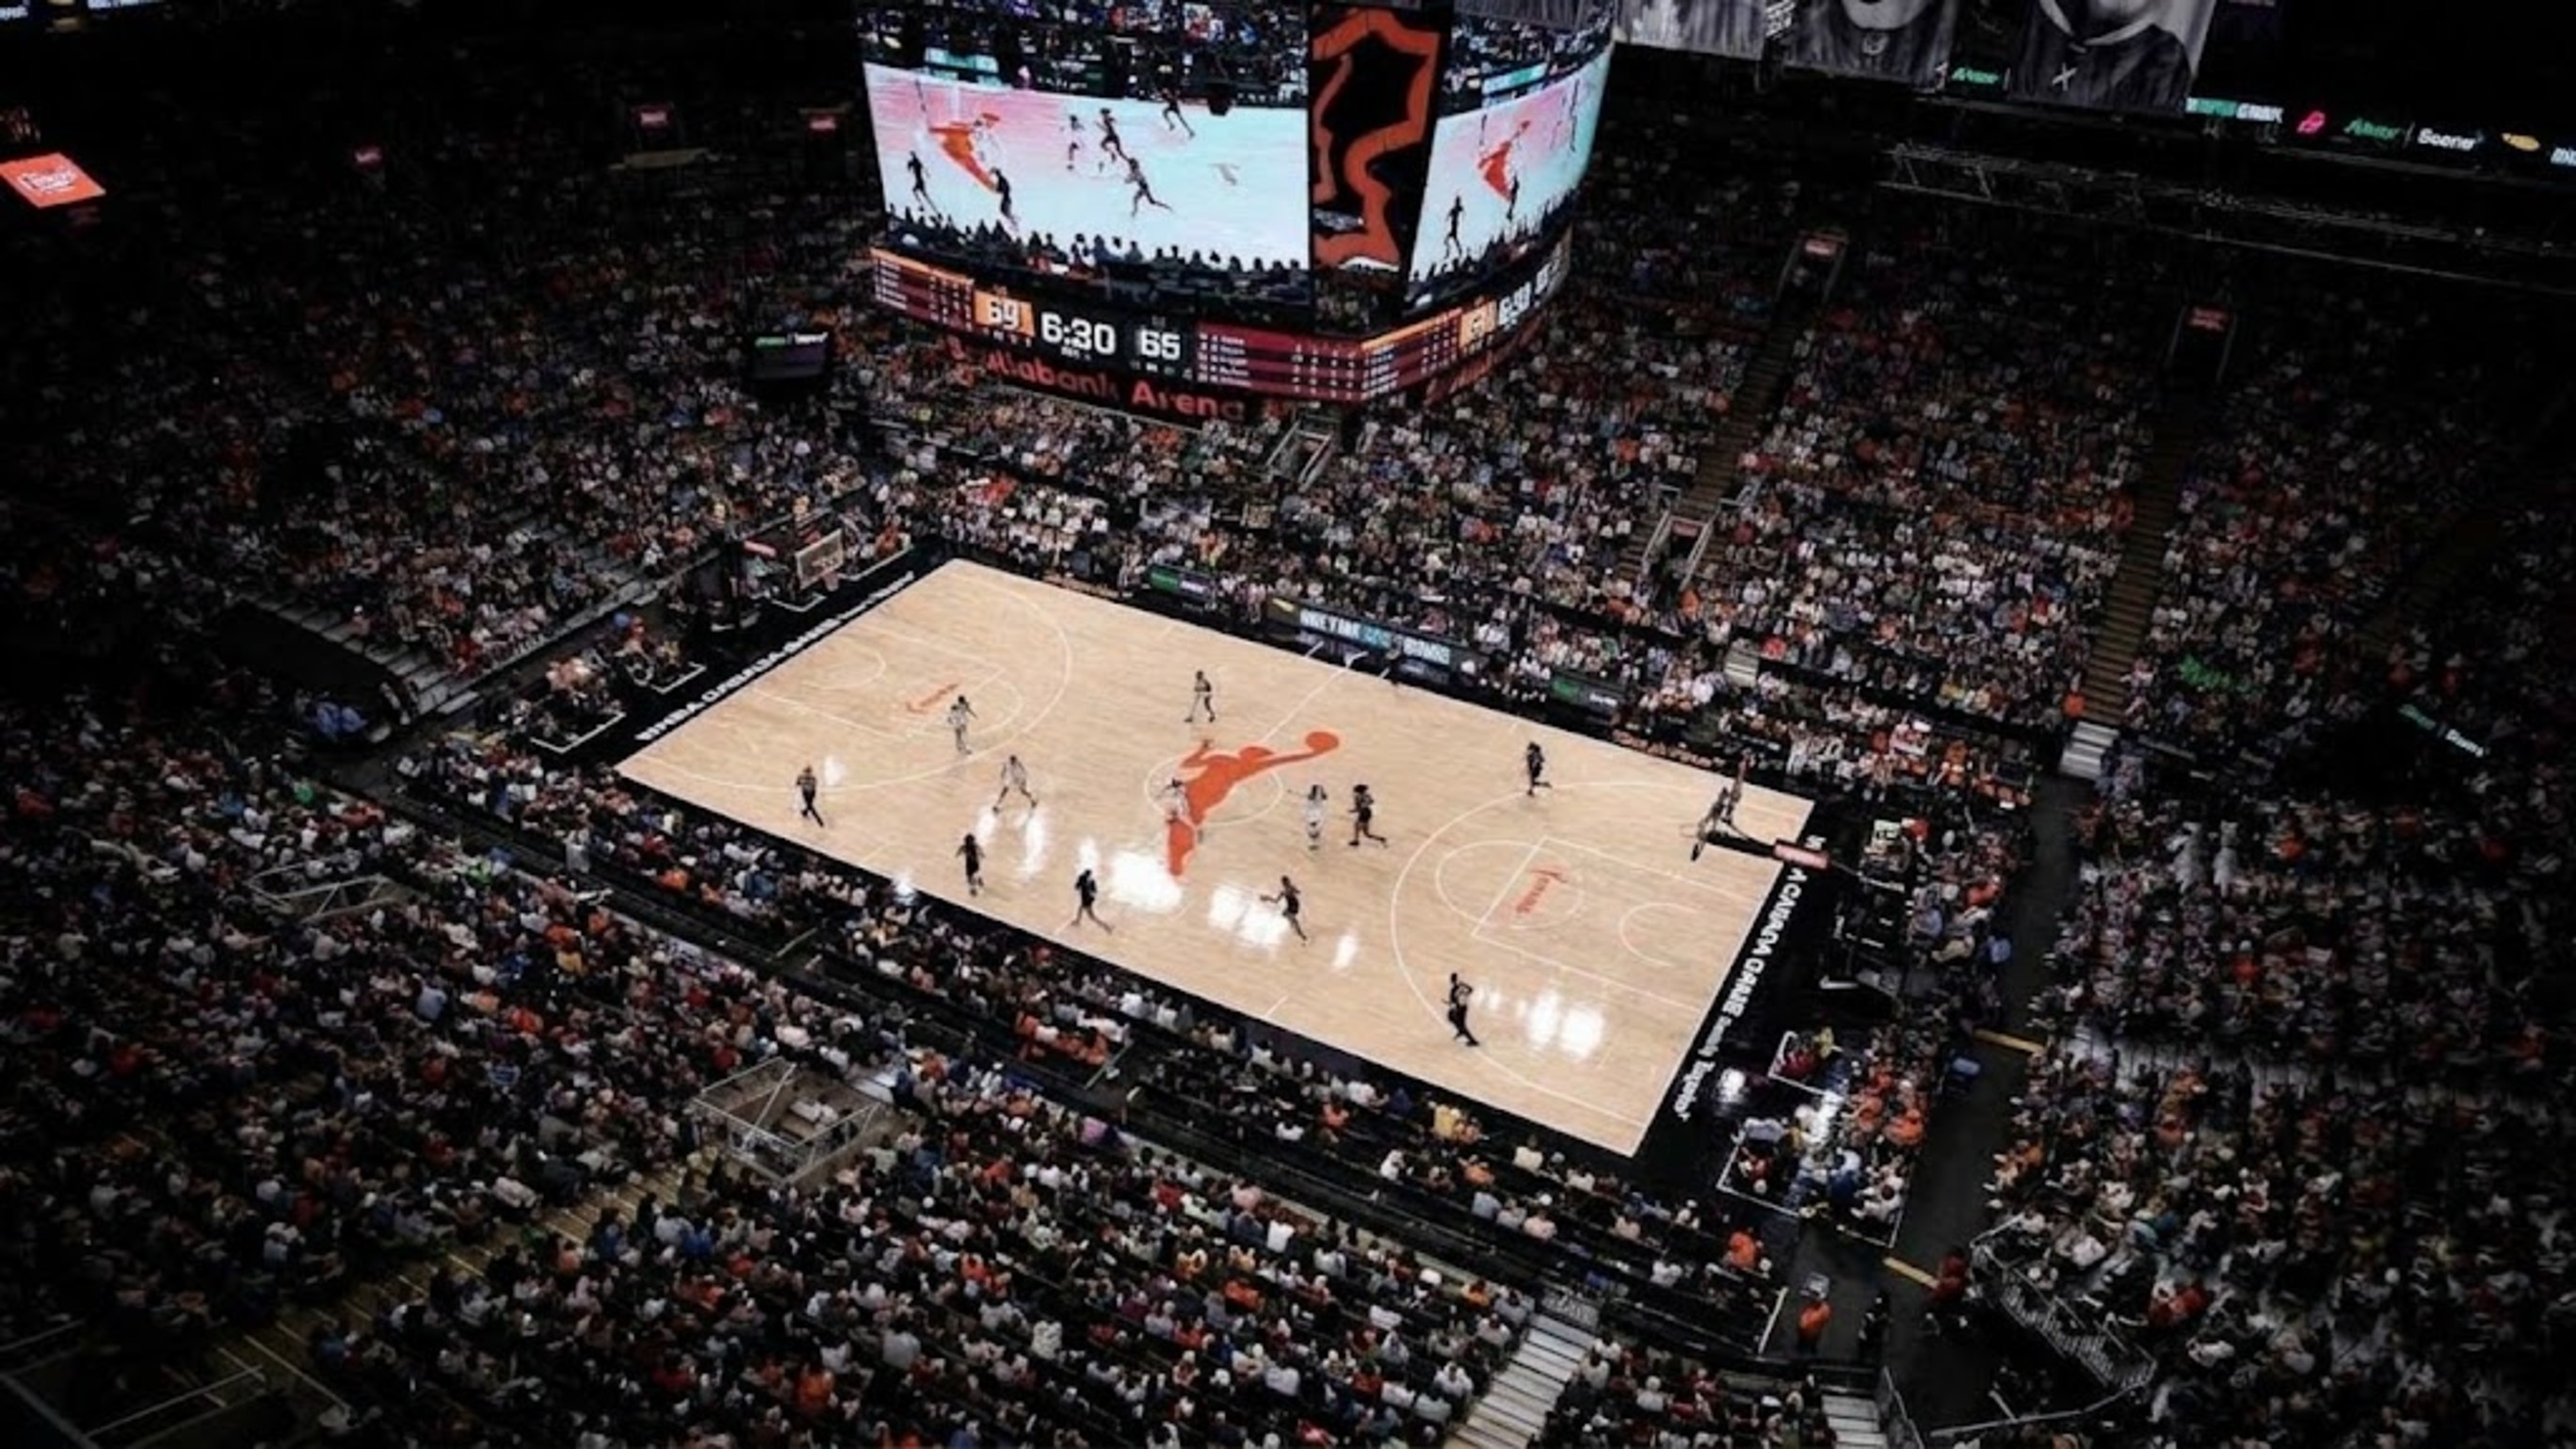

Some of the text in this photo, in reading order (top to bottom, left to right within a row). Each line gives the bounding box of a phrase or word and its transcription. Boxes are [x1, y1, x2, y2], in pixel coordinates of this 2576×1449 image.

[987, 293, 1019, 330] 69
[1040, 311, 1117, 355] 6:30
[1140, 328, 1181, 361] 65
